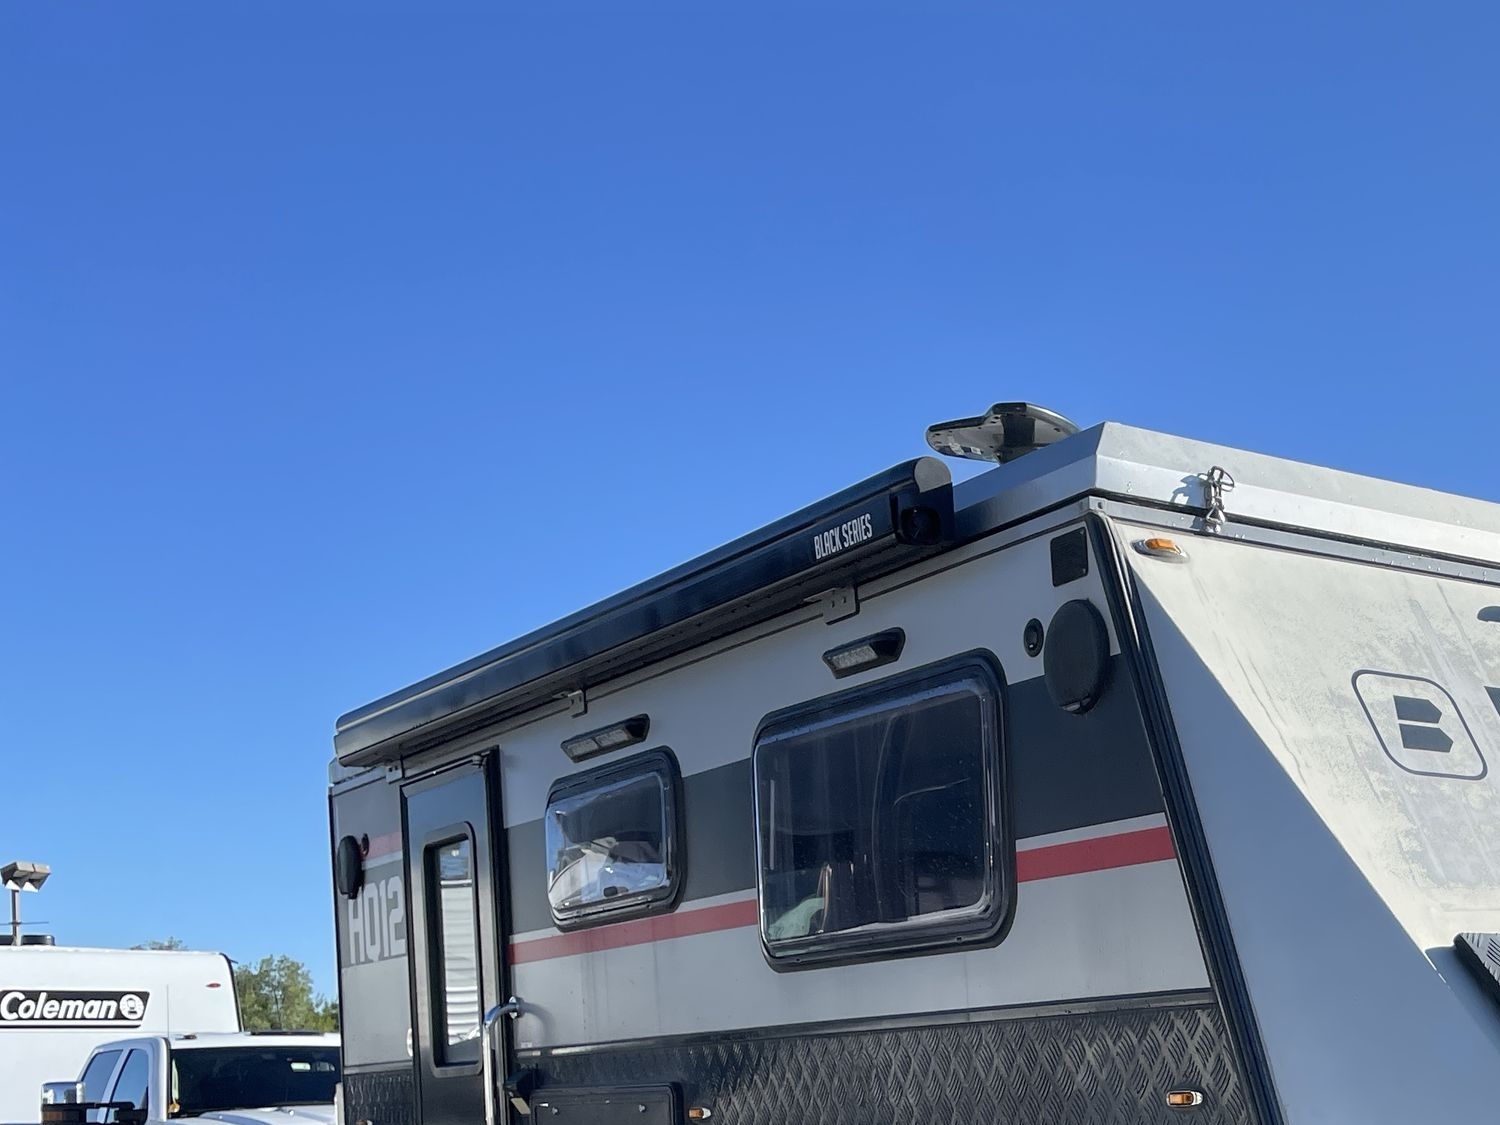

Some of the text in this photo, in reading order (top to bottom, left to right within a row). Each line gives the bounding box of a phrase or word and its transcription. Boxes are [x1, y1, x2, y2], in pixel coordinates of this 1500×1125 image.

[813, 513, 873, 560] BLACK SERIES
[0, 991, 118, 1020] Coleman
